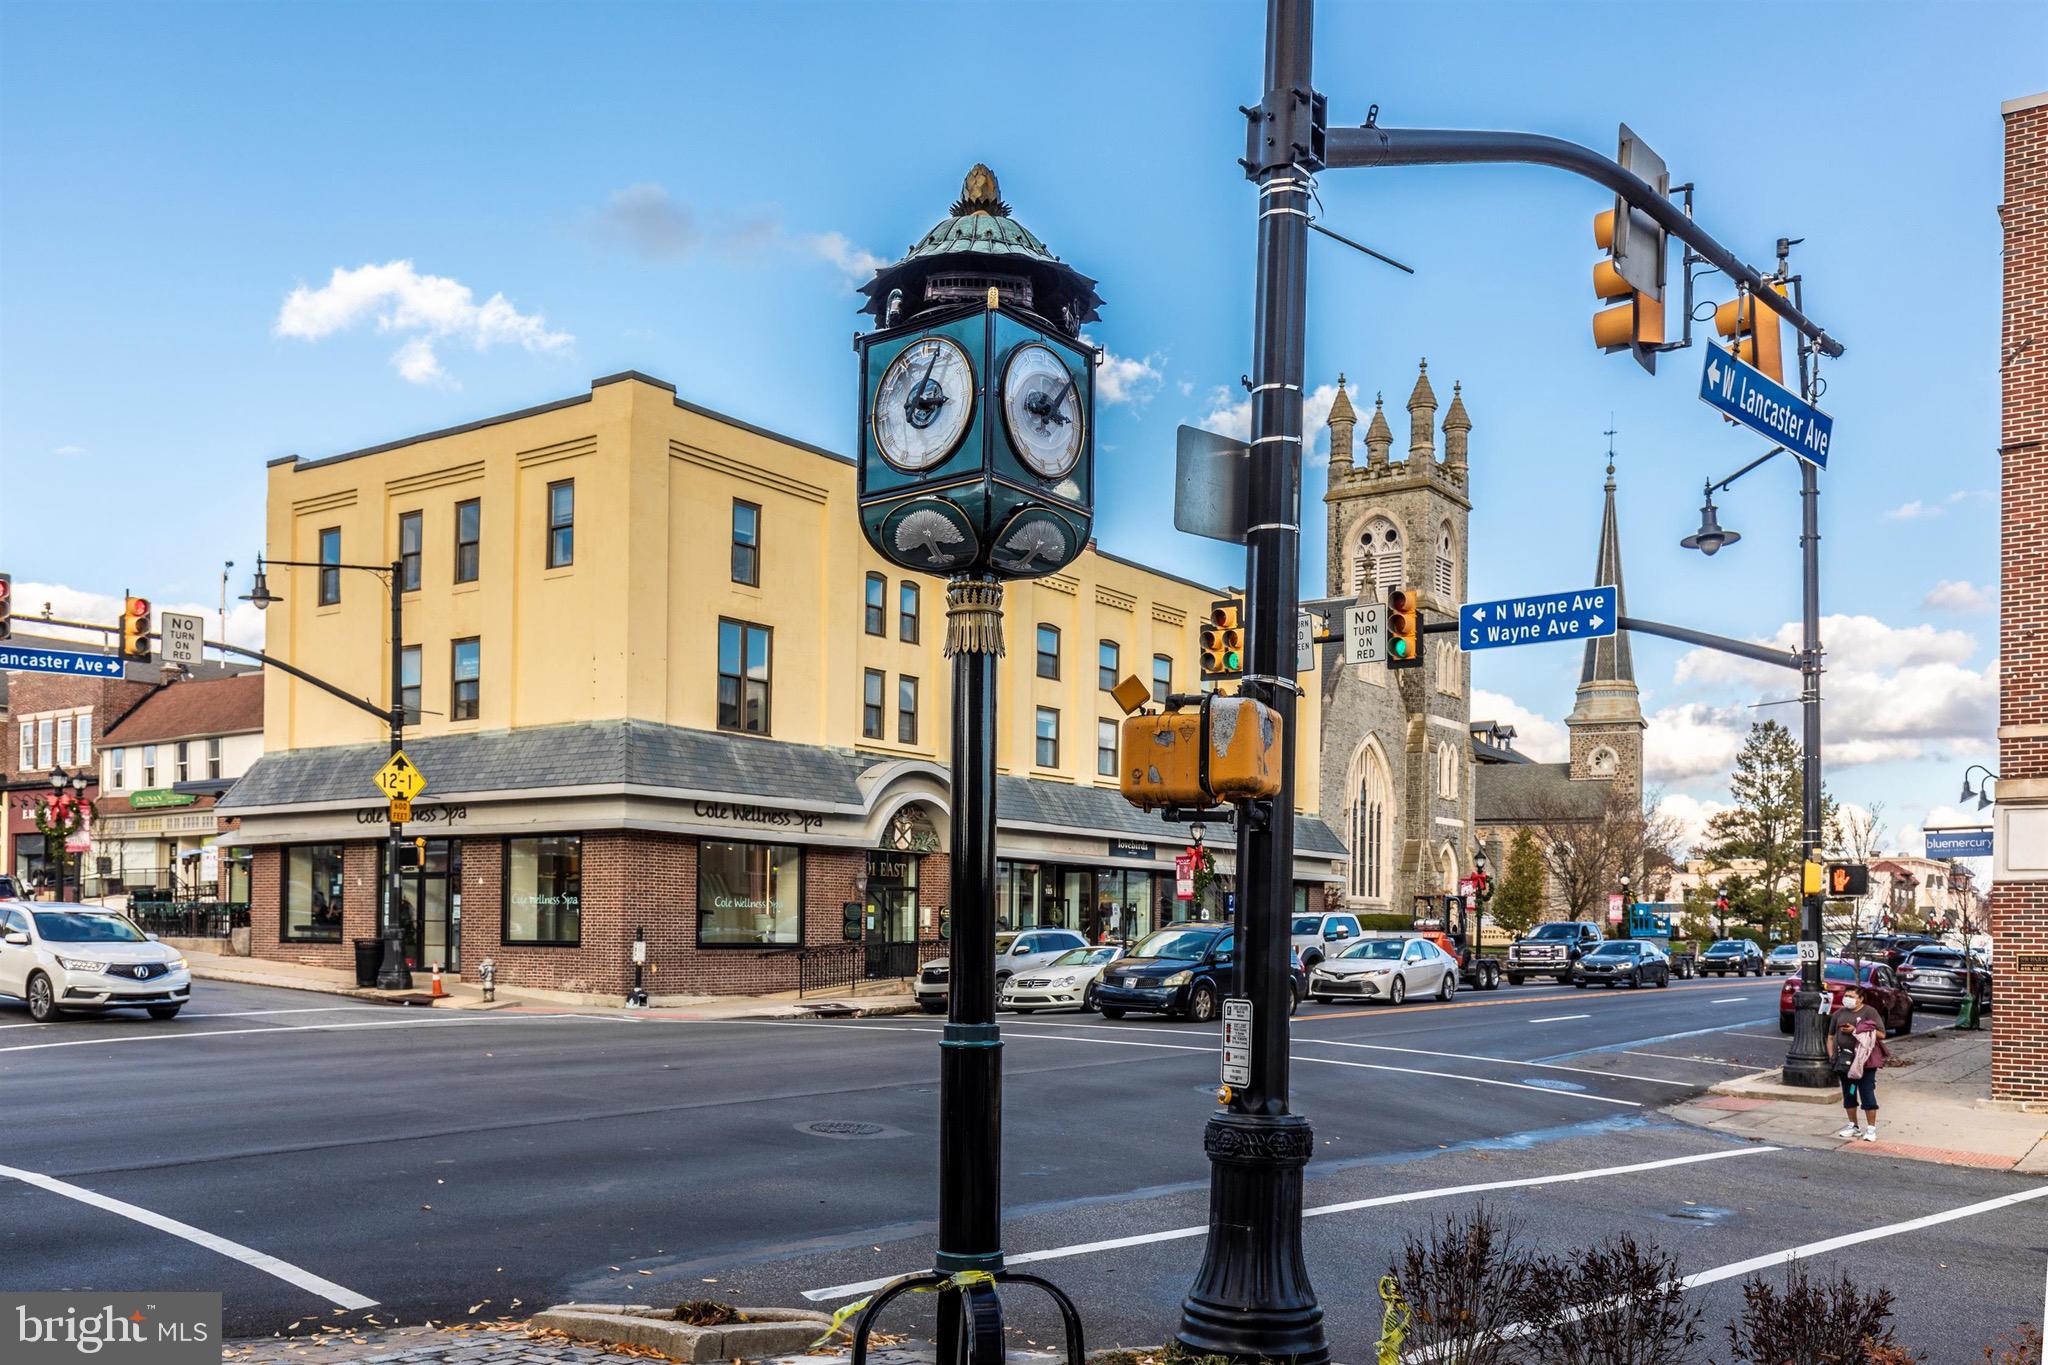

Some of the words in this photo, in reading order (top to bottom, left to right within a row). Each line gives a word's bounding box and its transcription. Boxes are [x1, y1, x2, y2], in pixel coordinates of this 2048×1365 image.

[1721, 364, 1736, 403] W.
[1739, 376, 1804, 441] Lancaster
[1804, 418, 1828, 456] Ave
[1496, 604, 1507, 621] N
[1513, 599, 1568, 619] Wayne
[1572, 595, 1604, 612] Ave
[1355, 610, 1376, 624] NO
[171, 618, 194, 630] NO
[170, 630, 195, 640] TURN
[1353, 625, 1378, 636] TURN
[1470, 628, 1480, 644] S
[1487, 624, 1540, 644] Wayne
[1547, 619, 1579, 635] Ave
[175, 641, 190, 650] ON
[1358, 638, 1373, 647] ON
[173, 651, 192, 661] RED
[1356, 649, 1375, 660] RED
[0, 652, 71, 669] ancaster
[74, 658, 104, 672] Ave
[356, 808, 384, 824] Cole
[439, 805, 467, 827] Spa
[393, 812, 408, 820] FEET
[694, 800, 729, 819] Cole
[731, 803, 791, 827] Wellness
[793, 808, 823, 833] Spa
[1926, 838, 1993, 849] bluemercury
[880, 862, 907, 878] EAST
[561, 892, 579, 910] Spa
[714, 896, 732, 908] Cole
[734, 897, 766, 908] Wellness
[1801, 949, 1815, 959] 30
